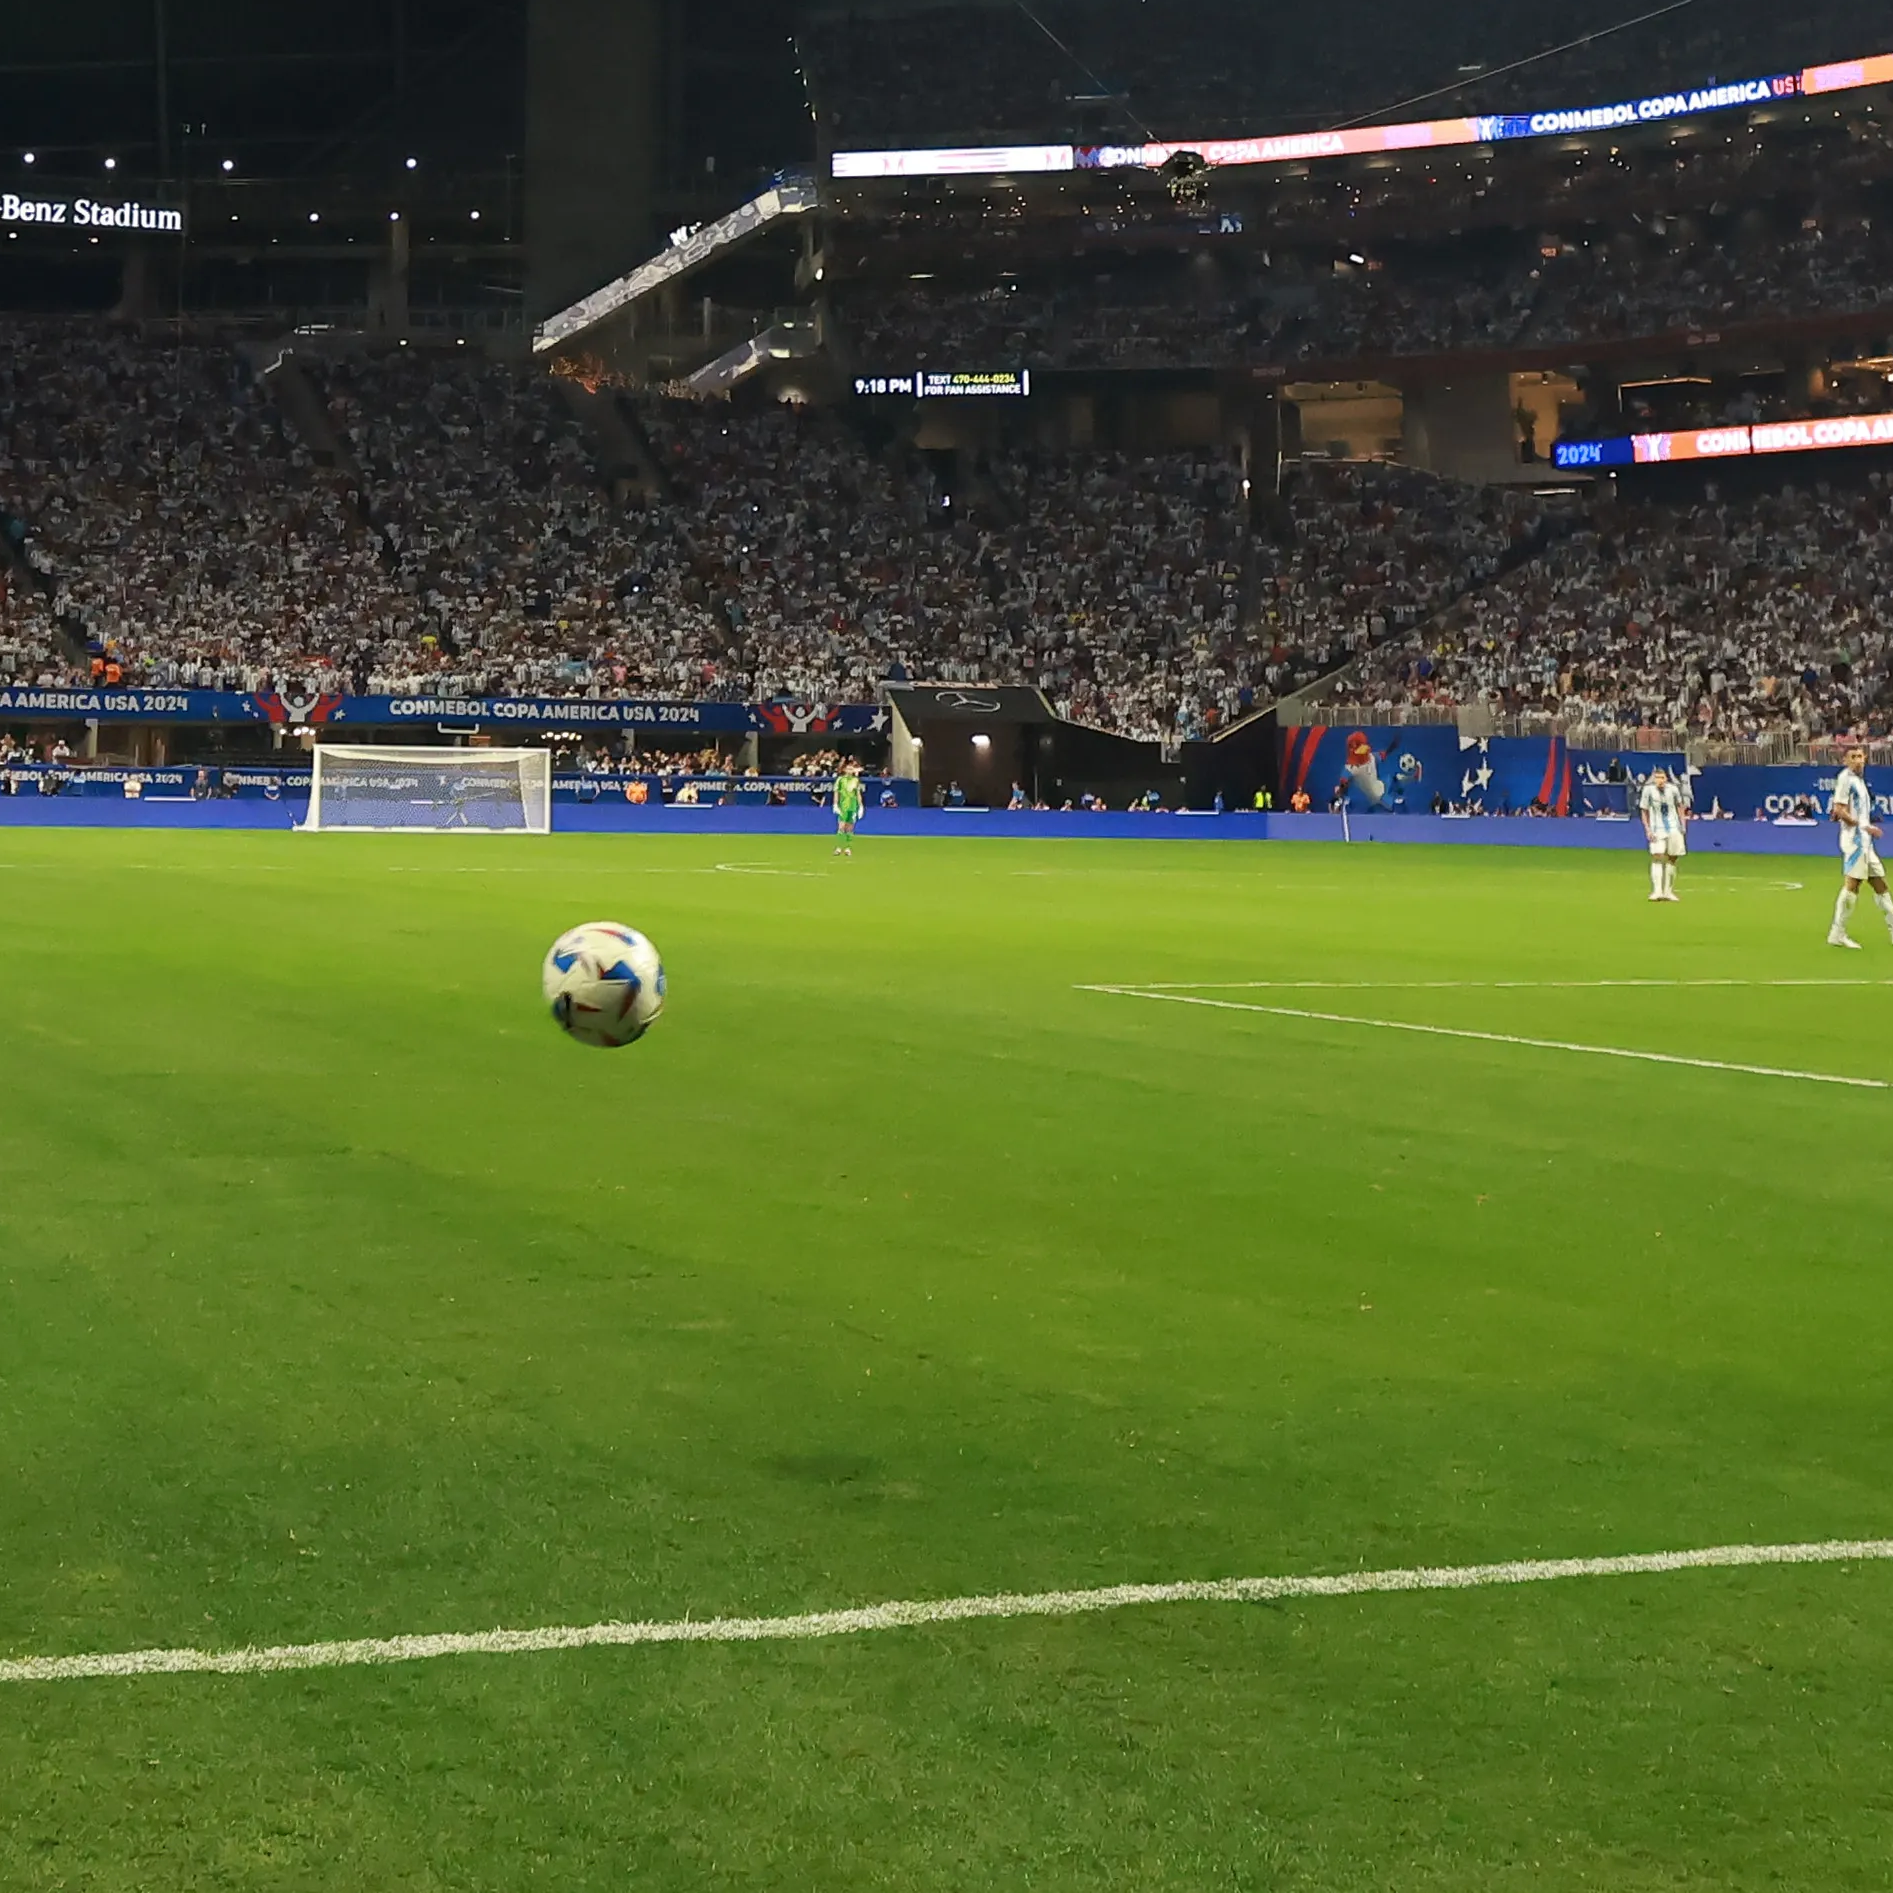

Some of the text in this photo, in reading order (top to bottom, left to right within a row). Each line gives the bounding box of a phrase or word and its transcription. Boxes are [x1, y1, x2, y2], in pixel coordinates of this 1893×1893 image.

[1529, 102, 1638, 134] CONMEBOL
[1638, 95, 1688, 120] COPA
[1688, 79, 1771, 111] AMERICA
[1261, 134, 1344, 157] AMERICA
[73, 198, 183, 232] Stadium
[855, 379, 912, 394] 9:18 PM
[924, 383, 1021, 396] FOR FAN ASSISTANCE
[928, 373, 1016, 385] TEXT 470-444-0234
[1813, 420, 1869, 444] COPA
[1556, 442, 1603, 466] 2024
[15, 693, 101, 710] AMERICA
[104, 695, 139, 712] USA
[143, 695, 189, 712] 2024
[389, 699, 700, 723] CONMEBOL COPA AMERICA USA 2024
[744, 782, 773, 792] COPA
